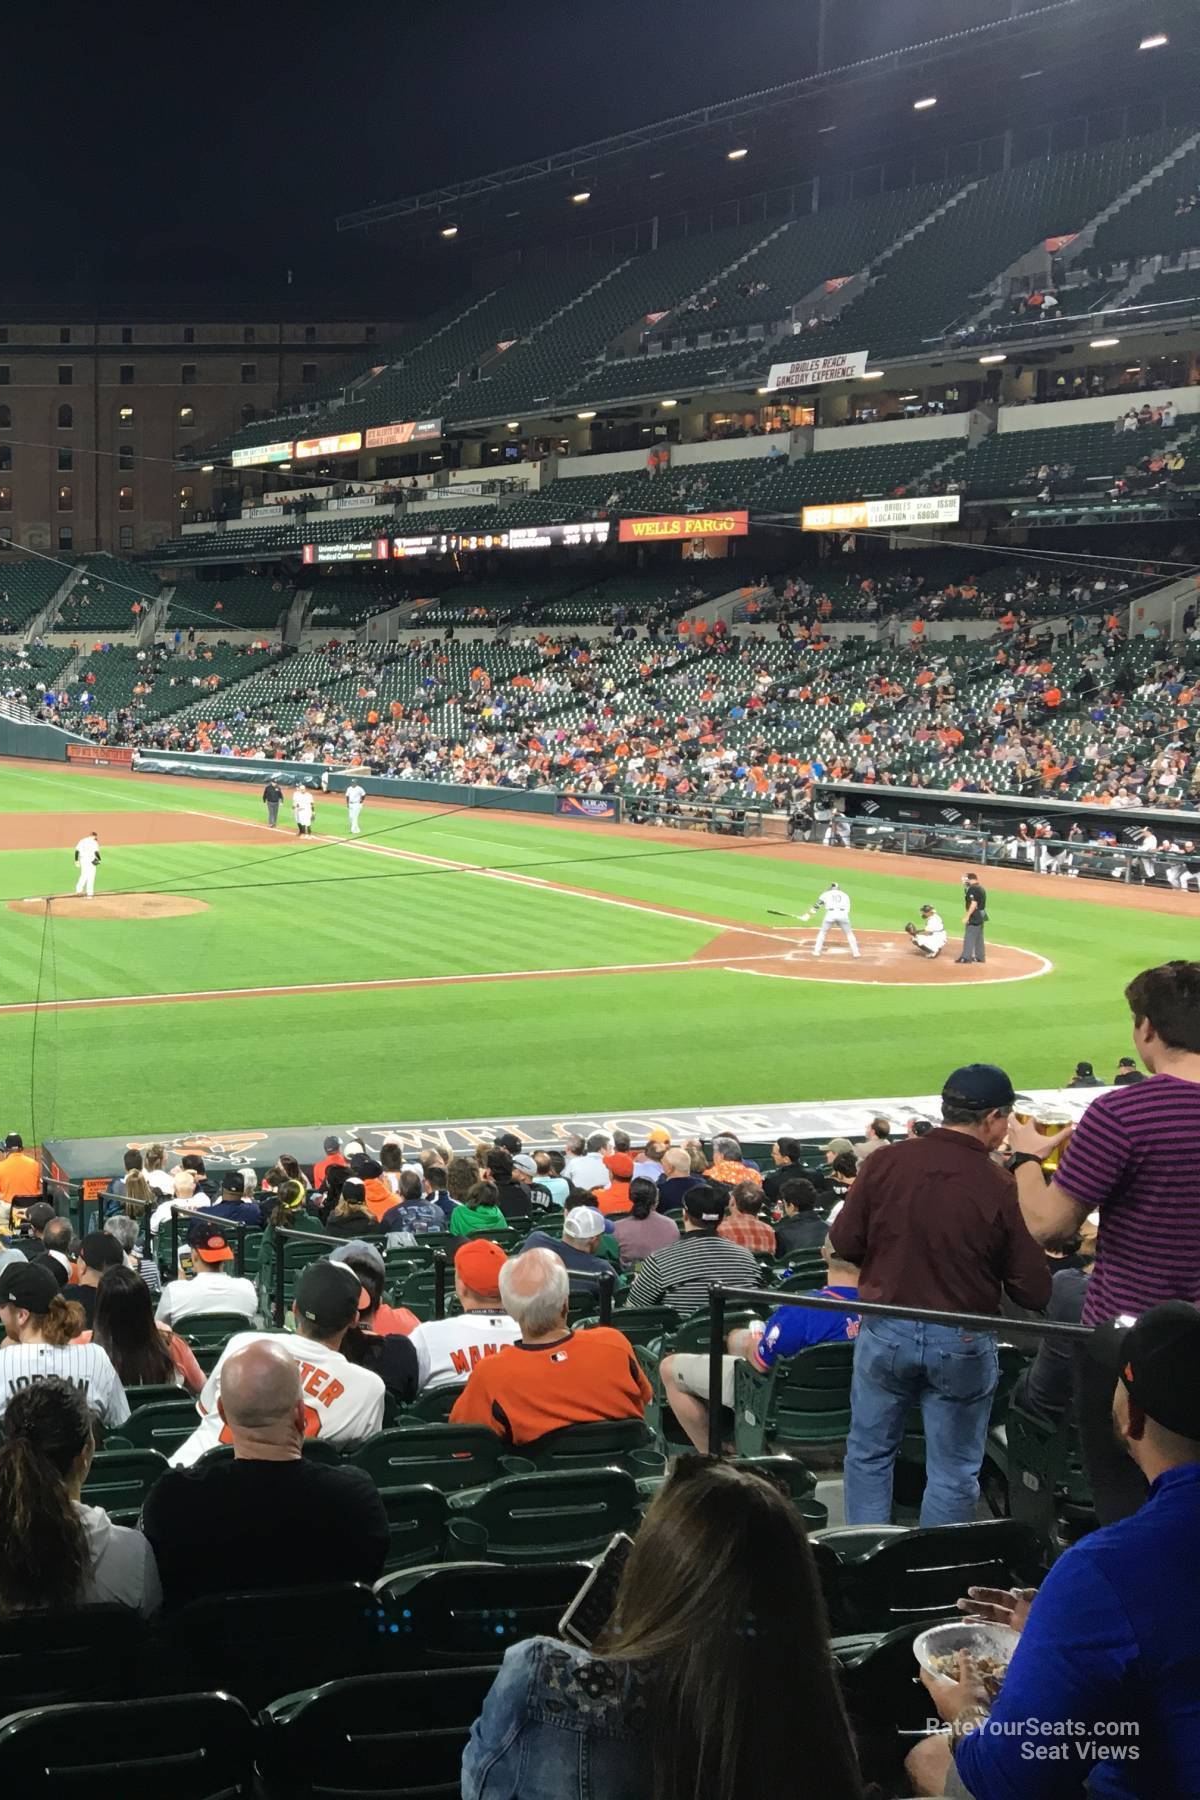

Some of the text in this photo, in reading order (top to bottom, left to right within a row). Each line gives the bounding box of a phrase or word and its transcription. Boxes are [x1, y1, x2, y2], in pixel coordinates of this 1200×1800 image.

[821, 356, 848, 369] REACH
[776, 366, 856, 387] GAMEDAY EXPERIENCE
[632, 517, 735, 536] WELLS FARGO
[318, 544, 342, 553] University
[295, 1360, 345, 1408] TER
